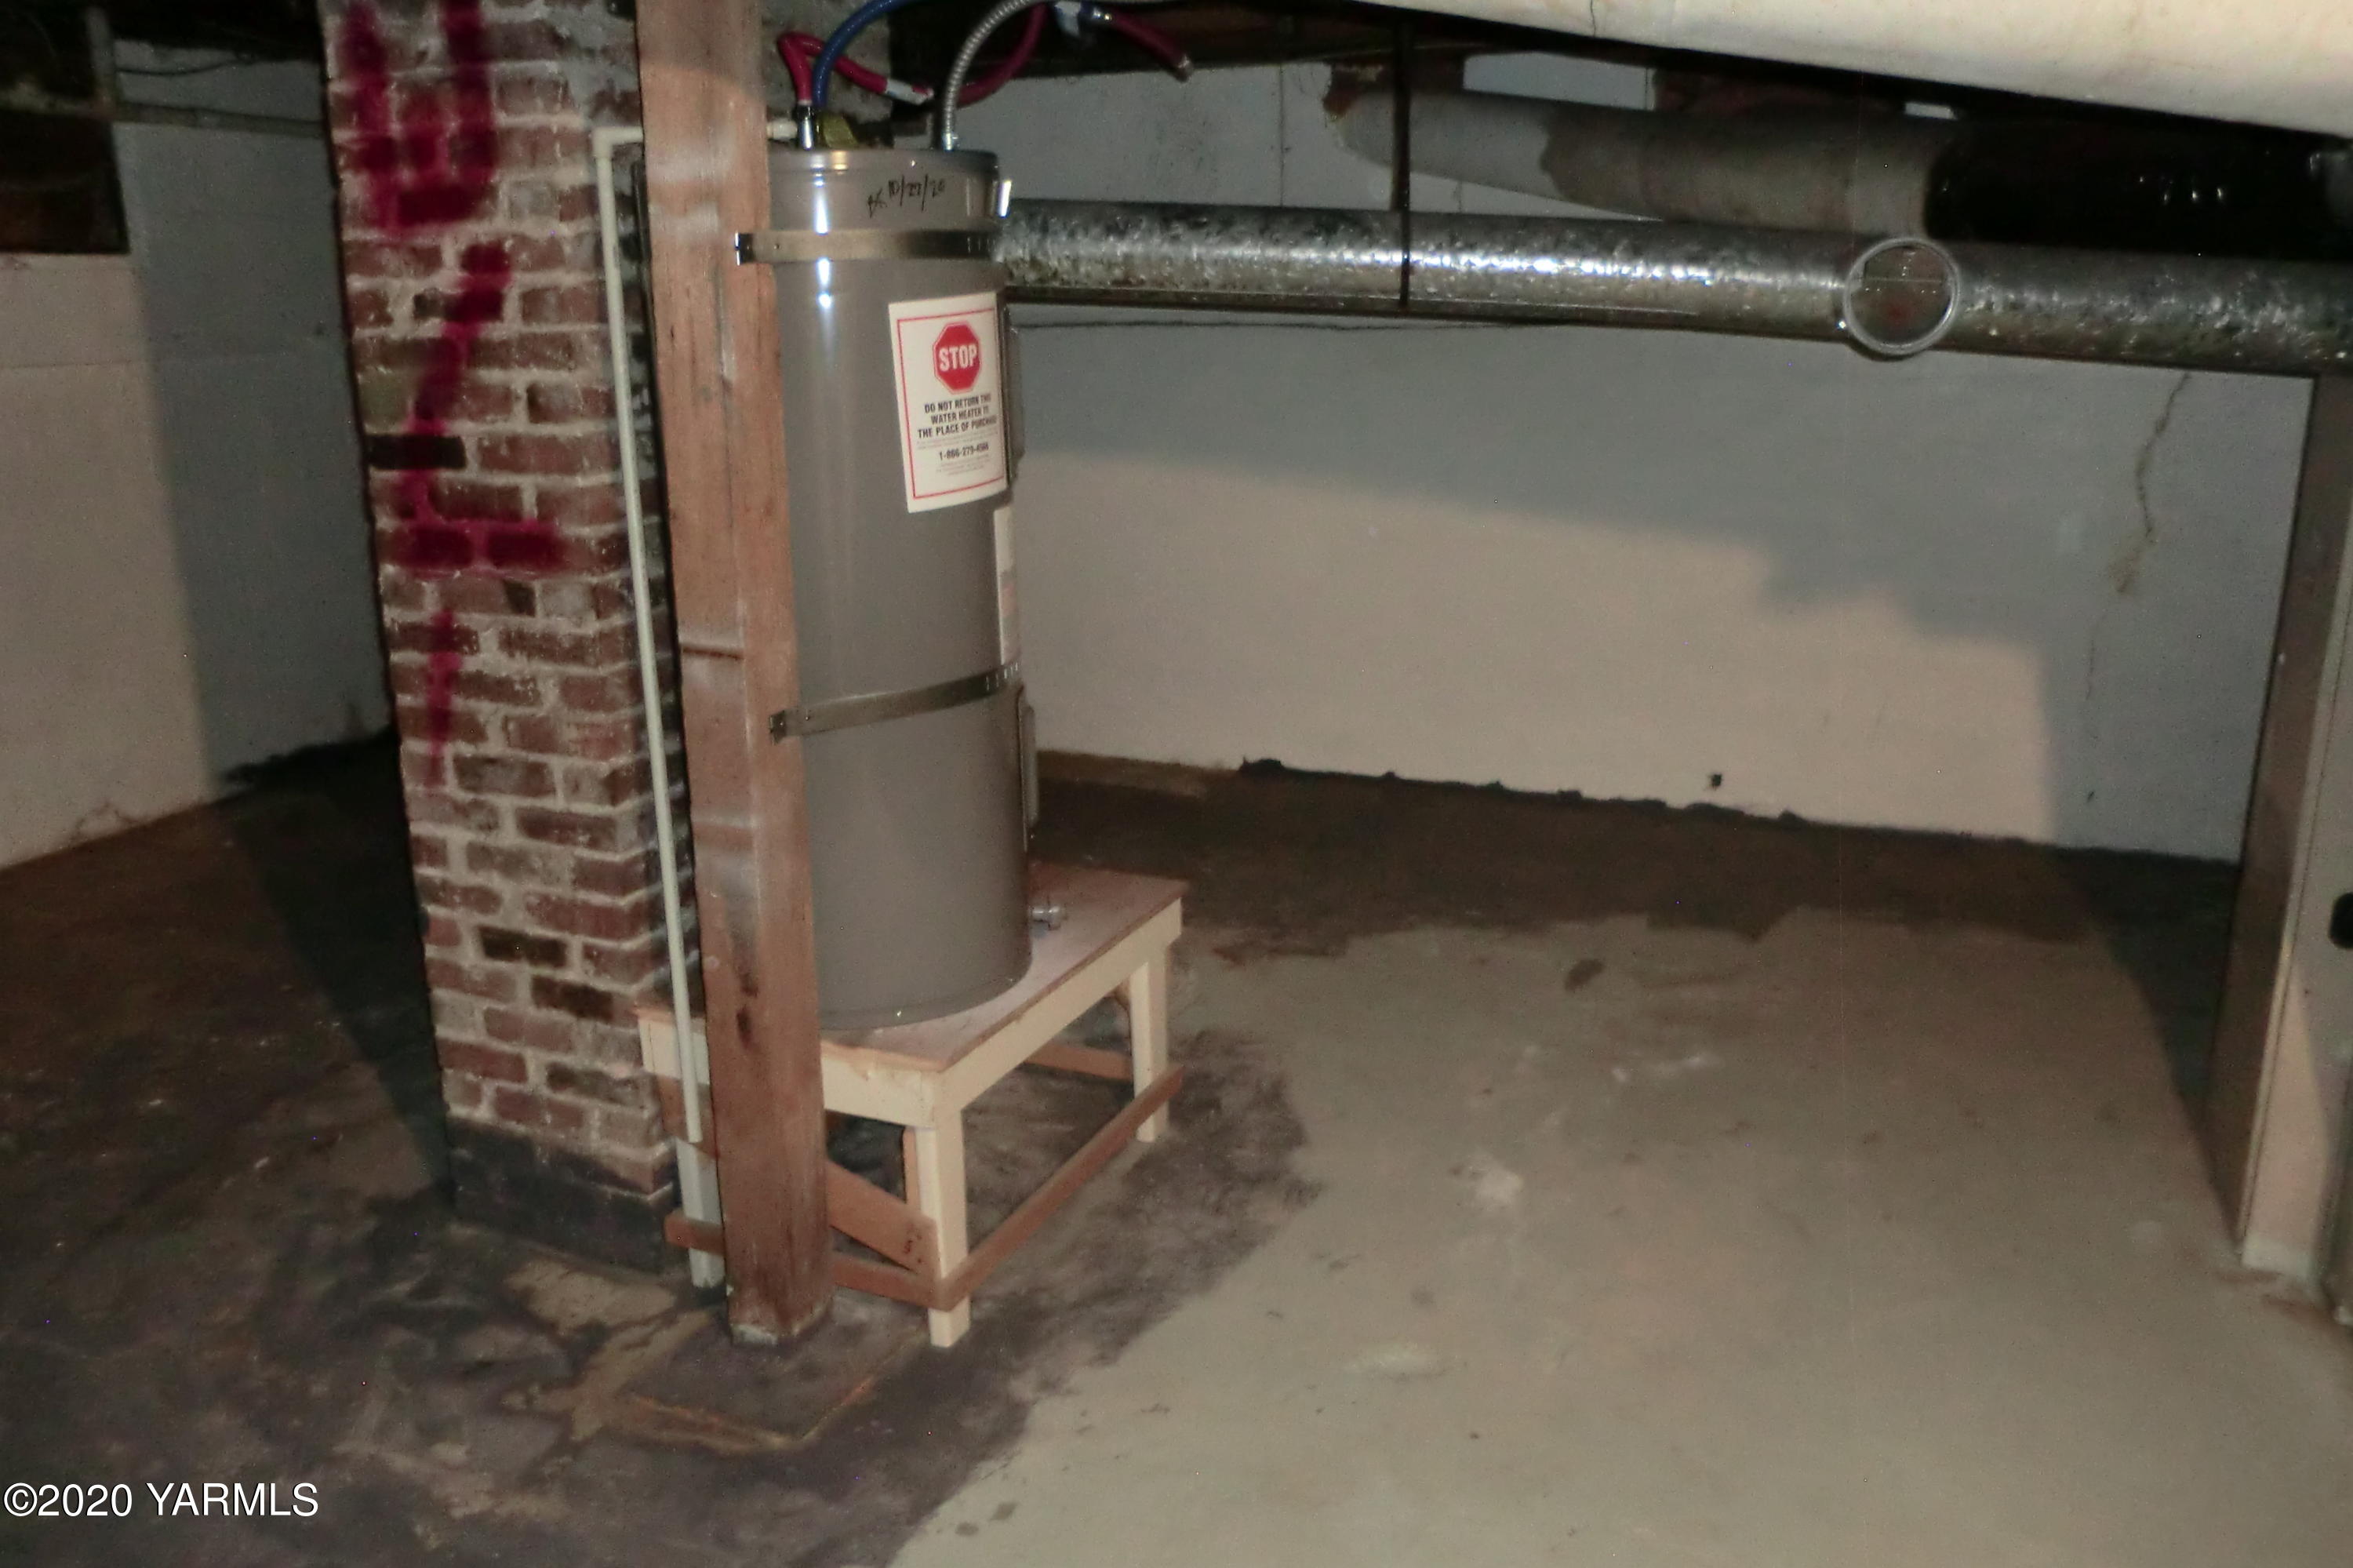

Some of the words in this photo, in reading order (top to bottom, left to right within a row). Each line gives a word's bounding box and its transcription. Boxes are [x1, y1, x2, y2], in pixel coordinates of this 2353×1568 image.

[939, 343, 977, 372] STOP
[925, 402, 936, 413] DO
[938, 400, 953, 412] NOT
[955, 395, 980, 409] RETURN
[931, 412, 957, 425] WATER
[958, 407, 982, 420] HEATER
[918, 427, 933, 438] THE
[936, 424, 959, 436] PLACE
[961, 421, 969, 431] OF
